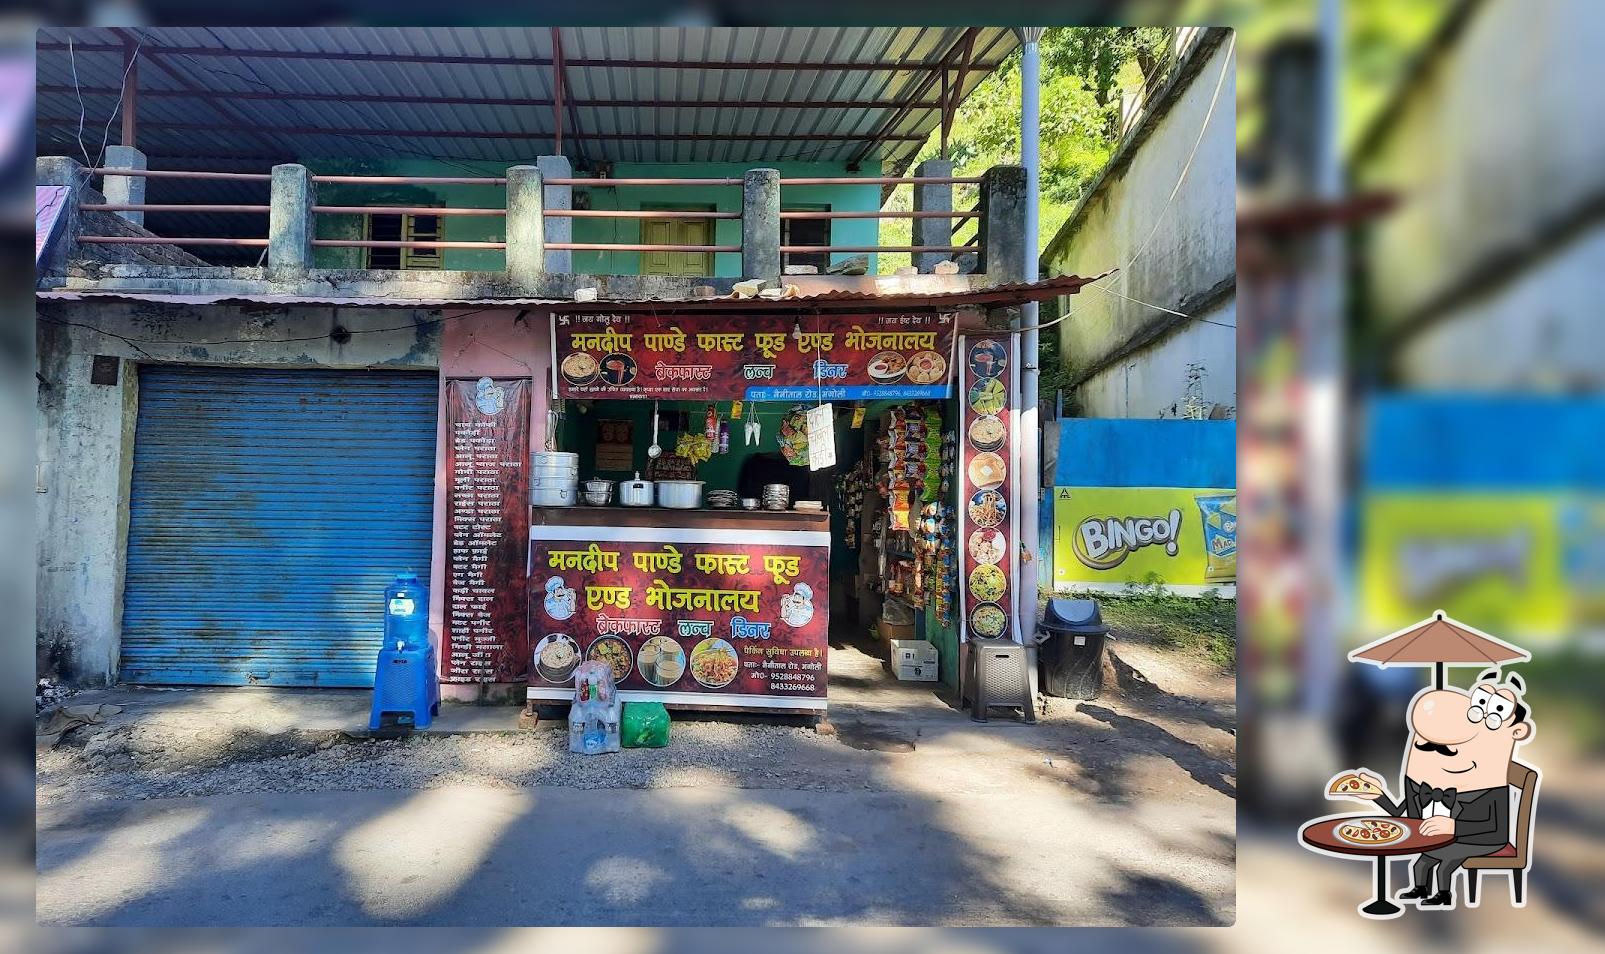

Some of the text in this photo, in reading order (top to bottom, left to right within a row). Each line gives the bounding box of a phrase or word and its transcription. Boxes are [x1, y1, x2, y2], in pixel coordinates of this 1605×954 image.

[582, 315, 594, 323] जय
[571, 326, 938, 359] मनदीप पाण्डे फास्ट फूड एण्ड भोजनालय
[655, 360, 848, 381] ब्रेकफास्ट लन्च डिनर
[1080, 508, 1183, 559] BINGO!
[548, 543, 801, 585] मनदीप पाण्डे फास्ट फूड
[585, 579, 762, 613] एण्ड भोजनालय
[596, 613, 771, 639] ब्रेकफास्ट लन्च डिनर
[765, 646, 787, 658] सुविधा
[770, 672, 815, 681] 9528848796
[770, 682, 815, 691] 8433269668
